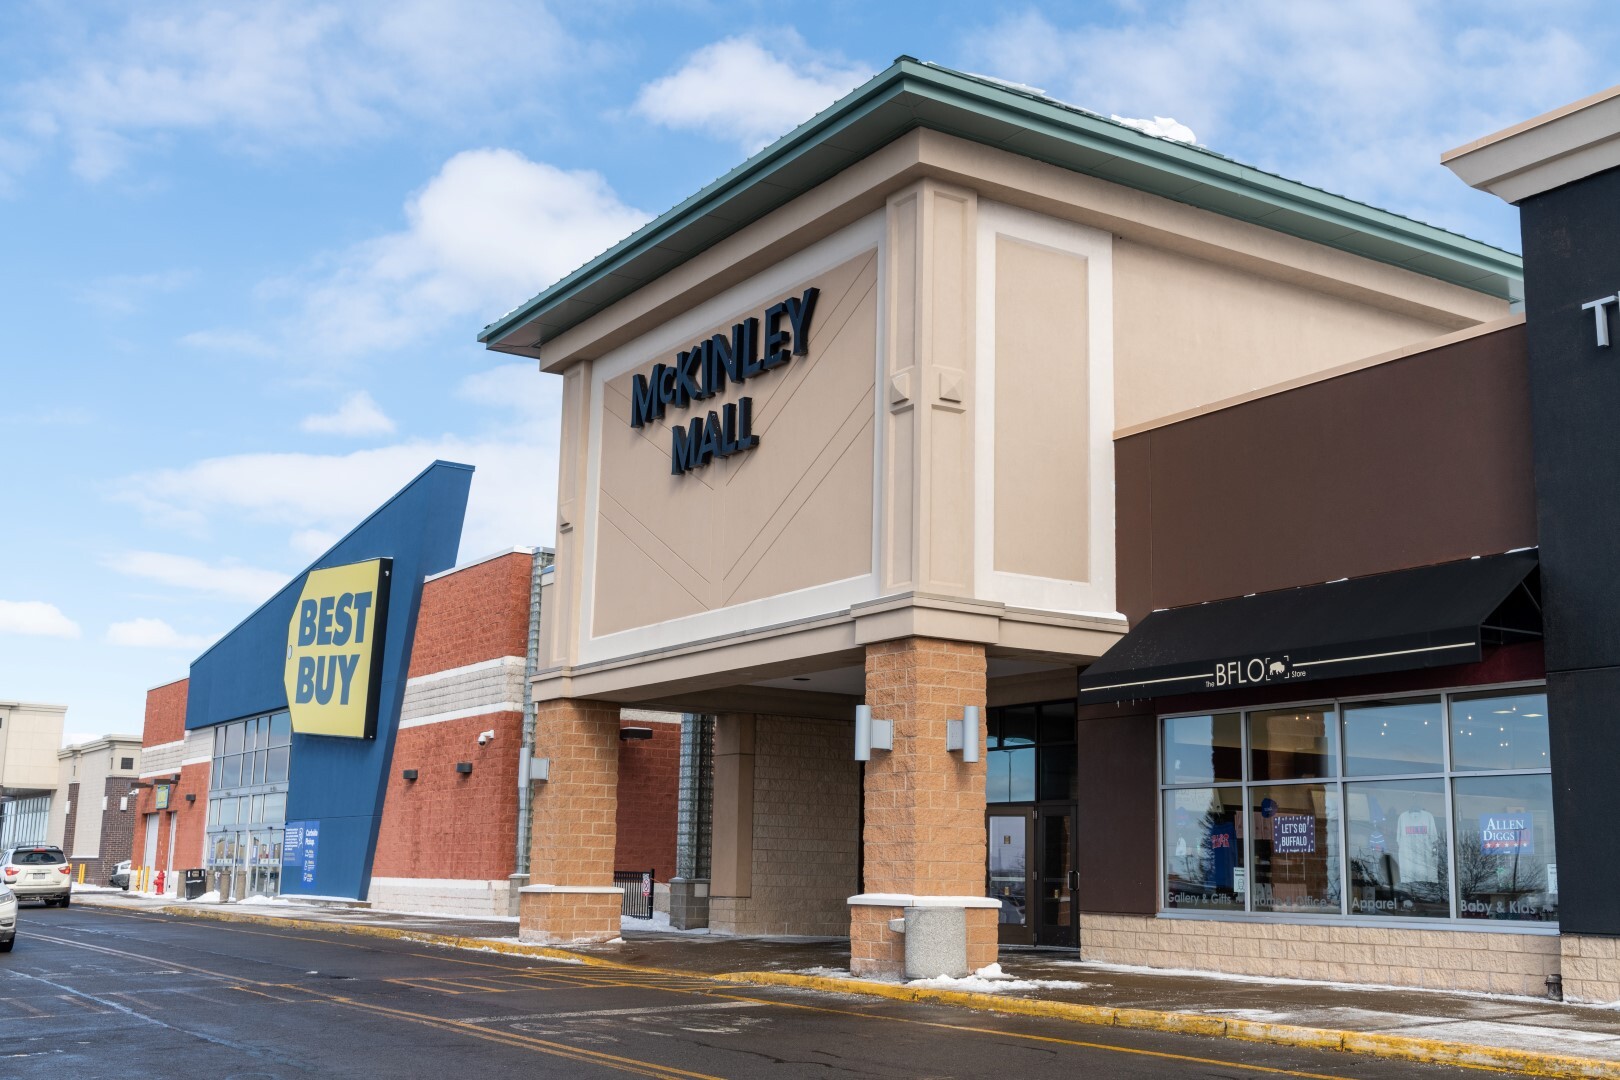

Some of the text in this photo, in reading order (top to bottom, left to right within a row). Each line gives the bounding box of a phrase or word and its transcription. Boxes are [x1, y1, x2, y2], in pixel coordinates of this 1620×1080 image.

[1582, 291, 1620, 346] T
[671, 397, 760, 475] MALL
[298, 591, 372, 647] BEST
[295, 654, 360, 705] BUY
[1216, 658, 1264, 686] BFLO
[1291, 670, 1306, 678] Store
[1281, 823, 1307, 834] LET'S GO
[1487, 818, 1524, 830] ALLEN
[1281, 836, 1307, 847] BUFFALO
[1483, 830, 1515, 841] DIGGS
[1167, 892, 1232, 906] Gallery & Gifts
[1352, 899, 1397, 914] Apparel
[1460, 900, 1536, 915] Baby & Kids
